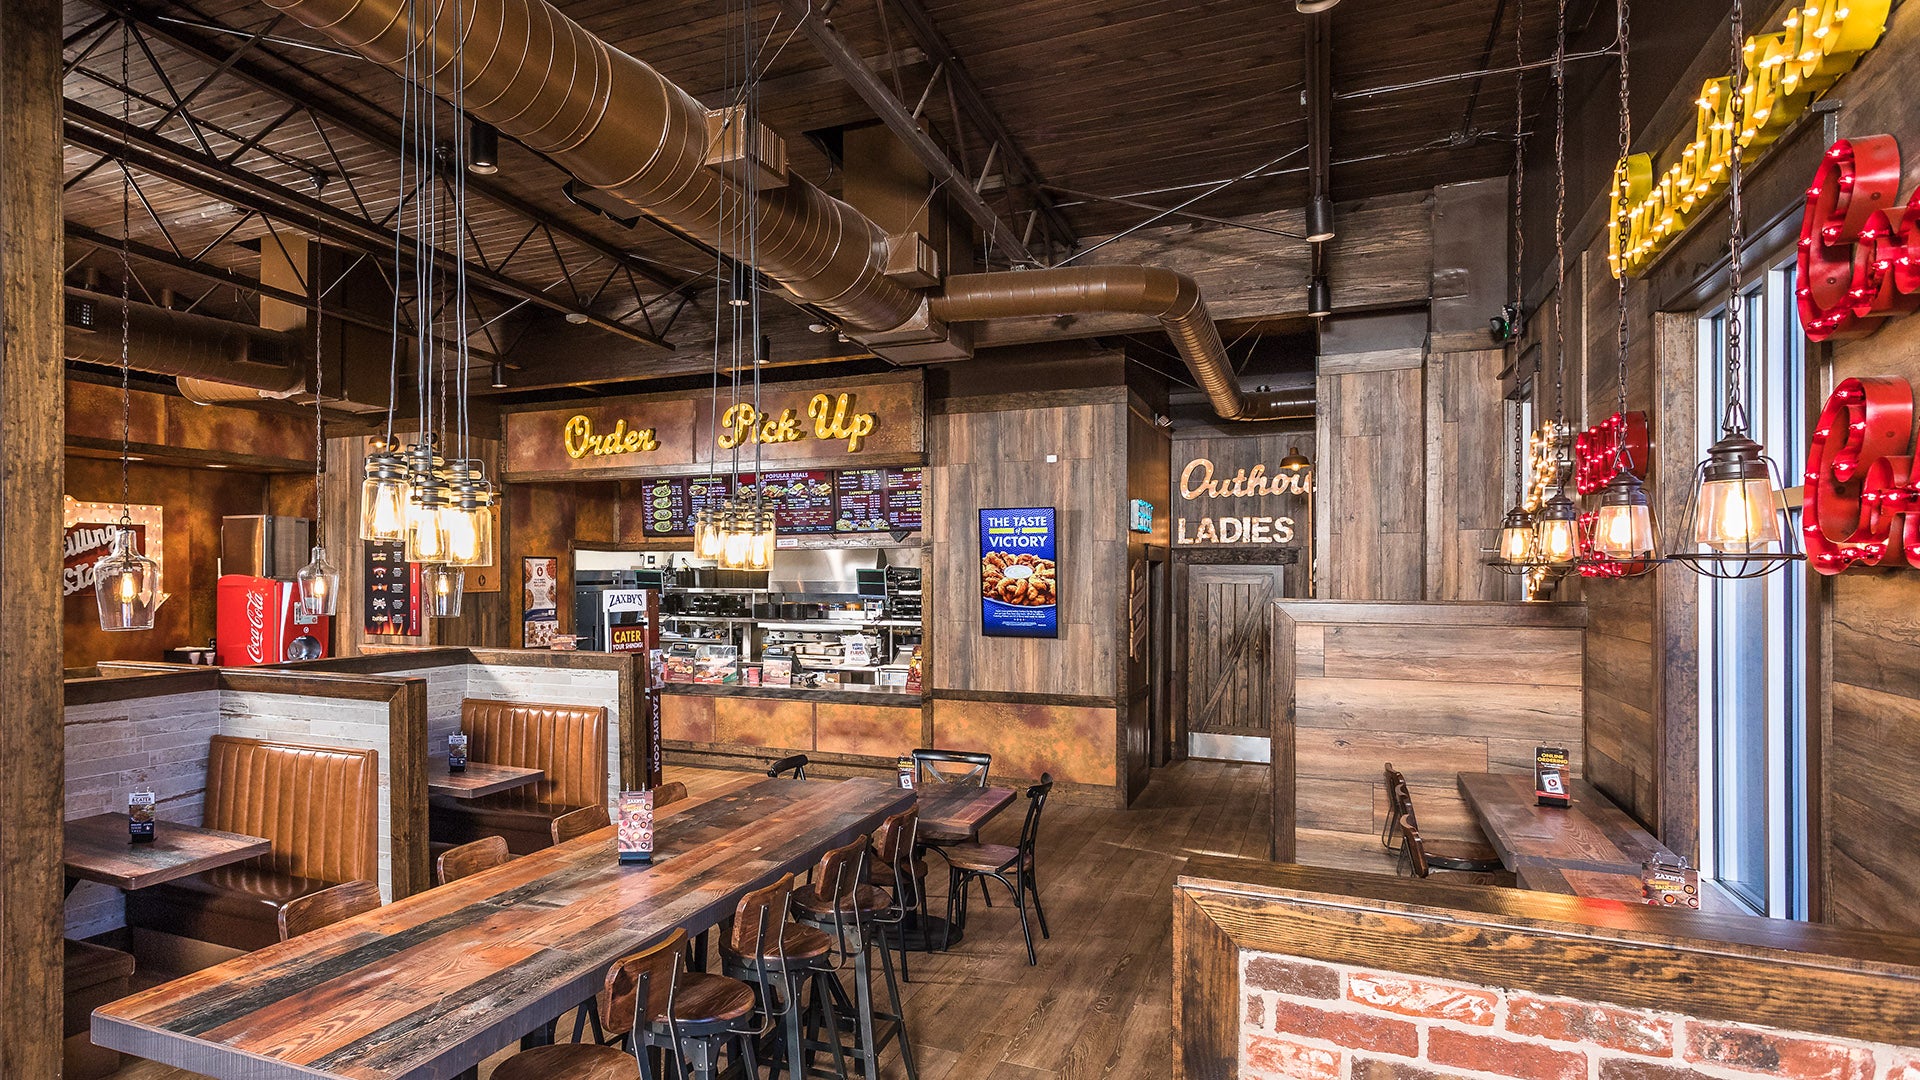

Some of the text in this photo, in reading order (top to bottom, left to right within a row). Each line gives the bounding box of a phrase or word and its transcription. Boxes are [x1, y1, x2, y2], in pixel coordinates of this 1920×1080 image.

[718, 393, 874, 452] Pick Up
[565, 415, 658, 459] Order
[1180, 458, 1311, 500] Outhou
[988, 516, 1047, 527] THE TASTE
[1015, 527, 1021, 535] of
[1177, 516, 1294, 545] LADIES
[988, 535, 1048, 548] VICTORY
[609, 594, 643, 607] ZAXBY'S
[246, 589, 264, 664] Coca-Cola
[614, 630, 641, 643] CATER
[612, 643, 625, 651] YOUR
[652, 695, 660, 773] ZAXBYS.COM
[1537, 756, 1568, 765] ORDERING
[1541, 752, 1564, 760] ONLINE
